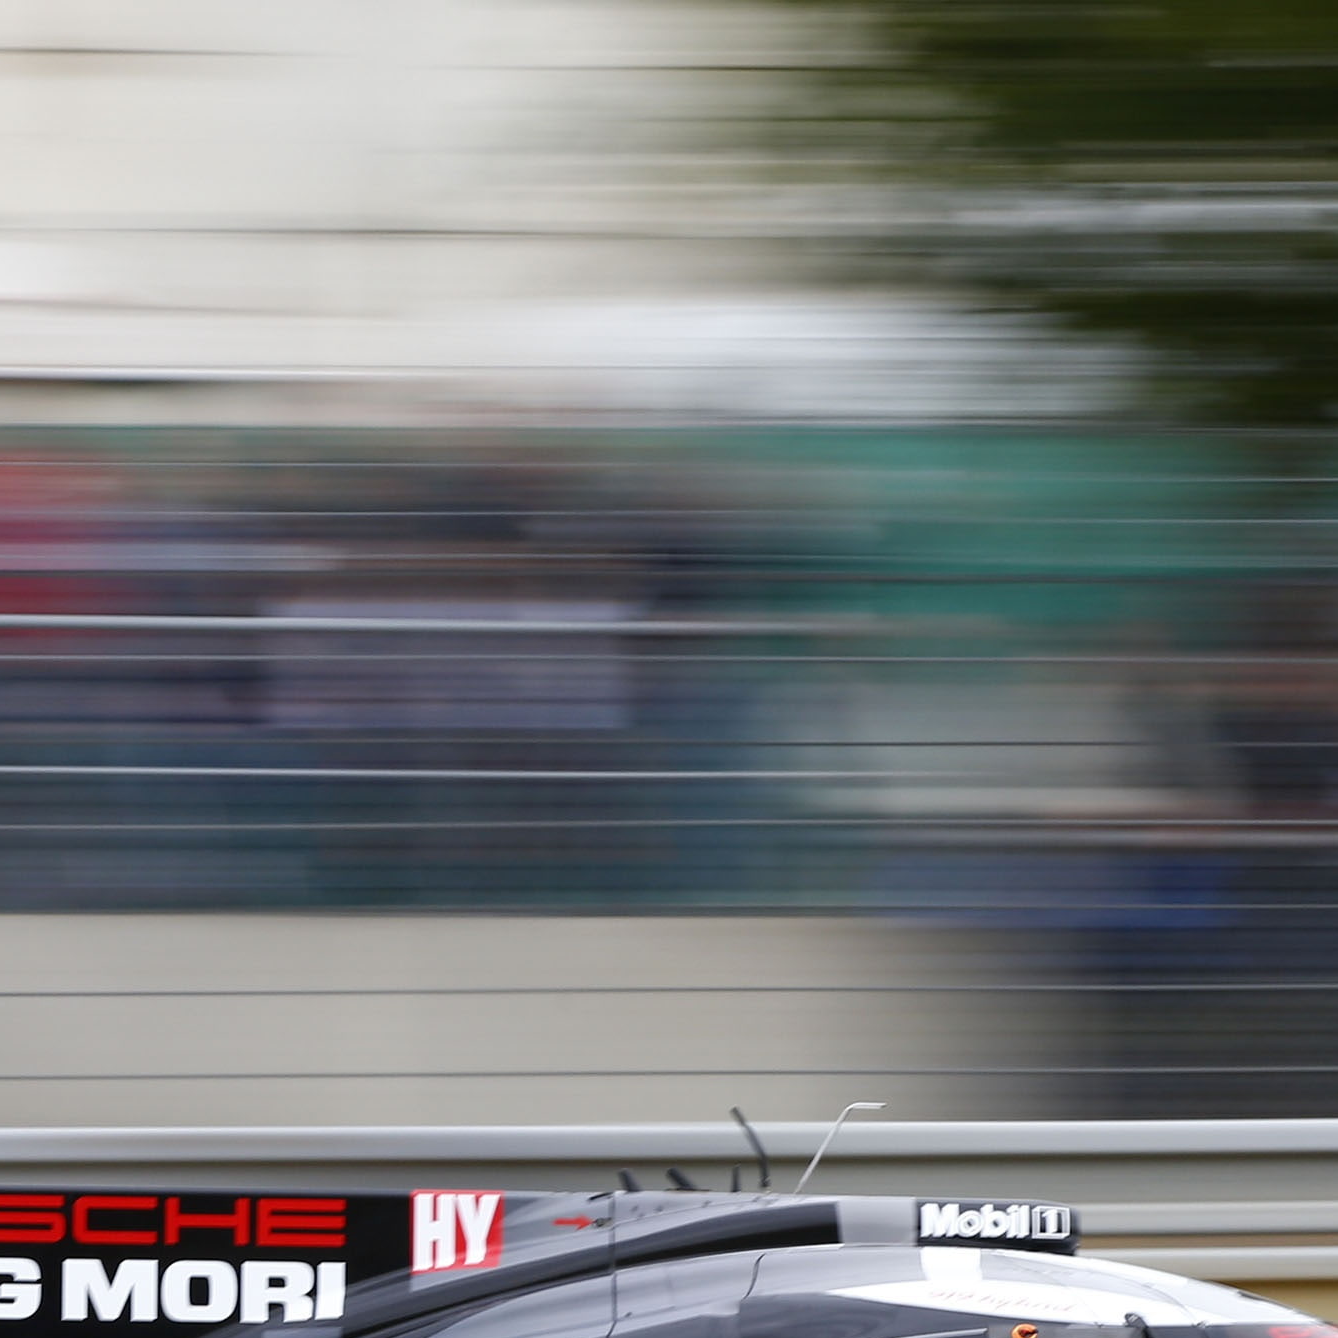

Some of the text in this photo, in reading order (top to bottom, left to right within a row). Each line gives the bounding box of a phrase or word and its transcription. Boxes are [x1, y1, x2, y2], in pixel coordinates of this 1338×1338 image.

[411, 1192, 501, 1272] HY
[919, 1203, 1030, 1239] Mobil
[61, 1257, 347, 1324] MORI
